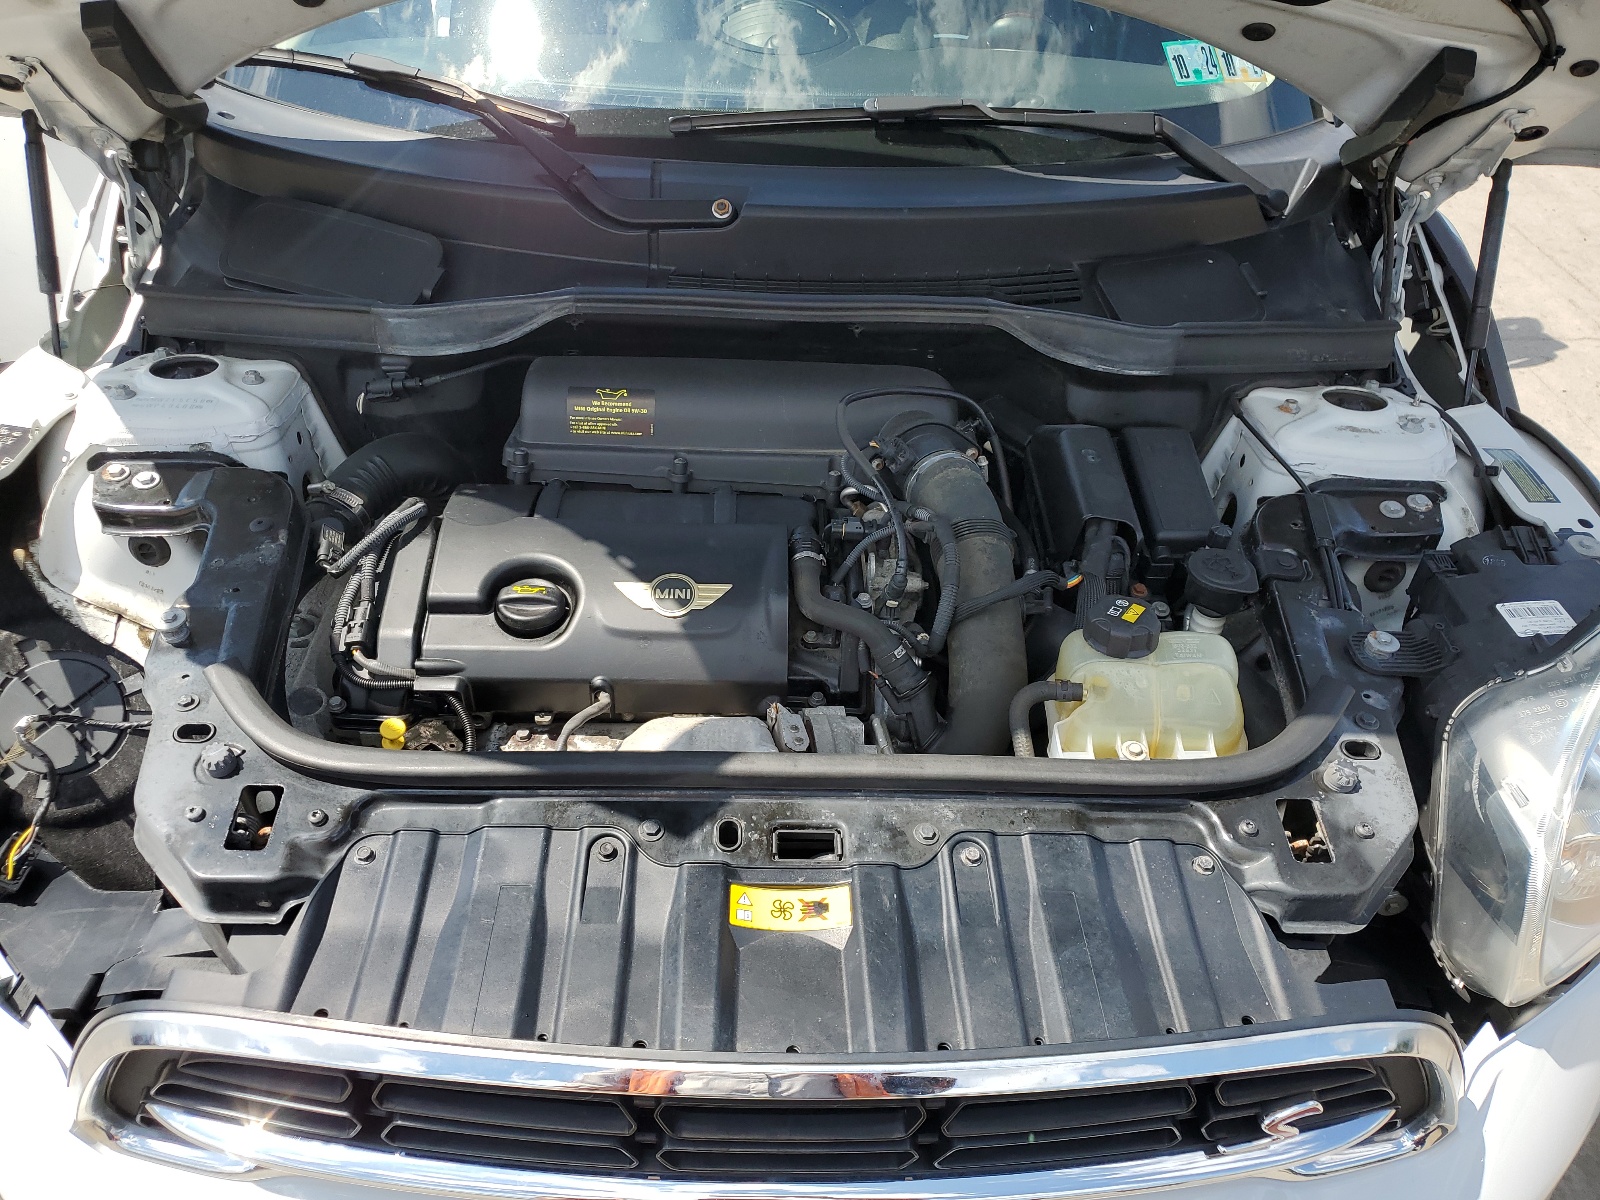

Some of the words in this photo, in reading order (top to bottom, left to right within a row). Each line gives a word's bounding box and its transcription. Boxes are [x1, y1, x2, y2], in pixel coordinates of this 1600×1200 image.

[1172, 54, 1190, 80] 10
[1201, 46, 1219, 77] 24
[655, 588, 691, 600] MINI
